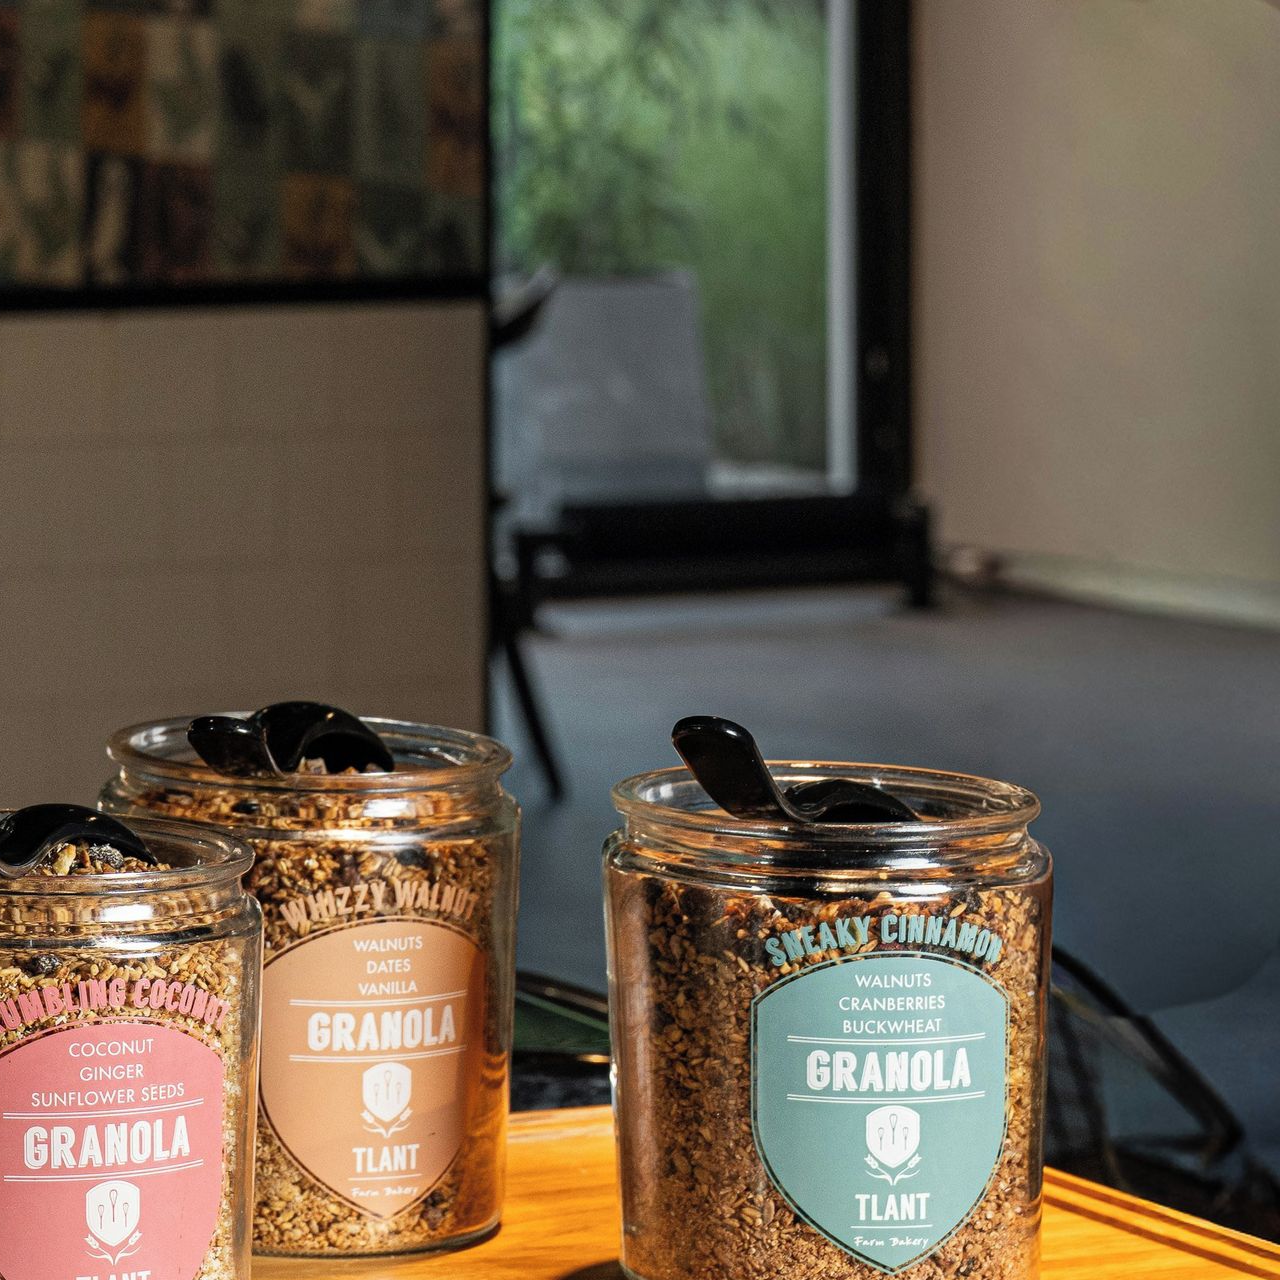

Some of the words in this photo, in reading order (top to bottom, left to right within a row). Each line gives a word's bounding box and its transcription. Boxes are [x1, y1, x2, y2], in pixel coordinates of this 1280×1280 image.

[279, 881, 387, 933] WHIZZY
[393, 880, 480, 920] WALNUT
[353, 936, 423, 952] WALNUTS
[765, 915, 872, 967] SNEAKY
[880, 914, 1003, 964] CINNAMON
[366, 959, 412, 974] DATES
[358, 980, 418, 996] VANILLA
[855, 973, 932, 988] WALNUTS
[134, 978, 230, 1032] COCONUT
[839, 995, 946, 1011] CRANBERRIES
[307, 1004, 457, 1052] GRANOLA
[842, 1018, 942, 1034] BUCKWHEAT
[69, 1038, 154, 1057] COCONUT
[79, 1063, 145, 1082] GINGER
[806, 1047, 972, 1092] GRANOLA
[31, 1088, 135, 1107] SUNFLOWER
[141, 1082, 185, 1103] SEEDS
[24, 1115, 191, 1169] GRANOLA
[351, 1143, 420, 1173] TLANT
[351, 1187, 379, 1197] Farm
[383, 1186, 418, 1196] Bakery
[854, 1192, 931, 1221] TLANT
[853, 1236, 885, 1247] Farm
[889, 1236, 929, 1249] Bakery
